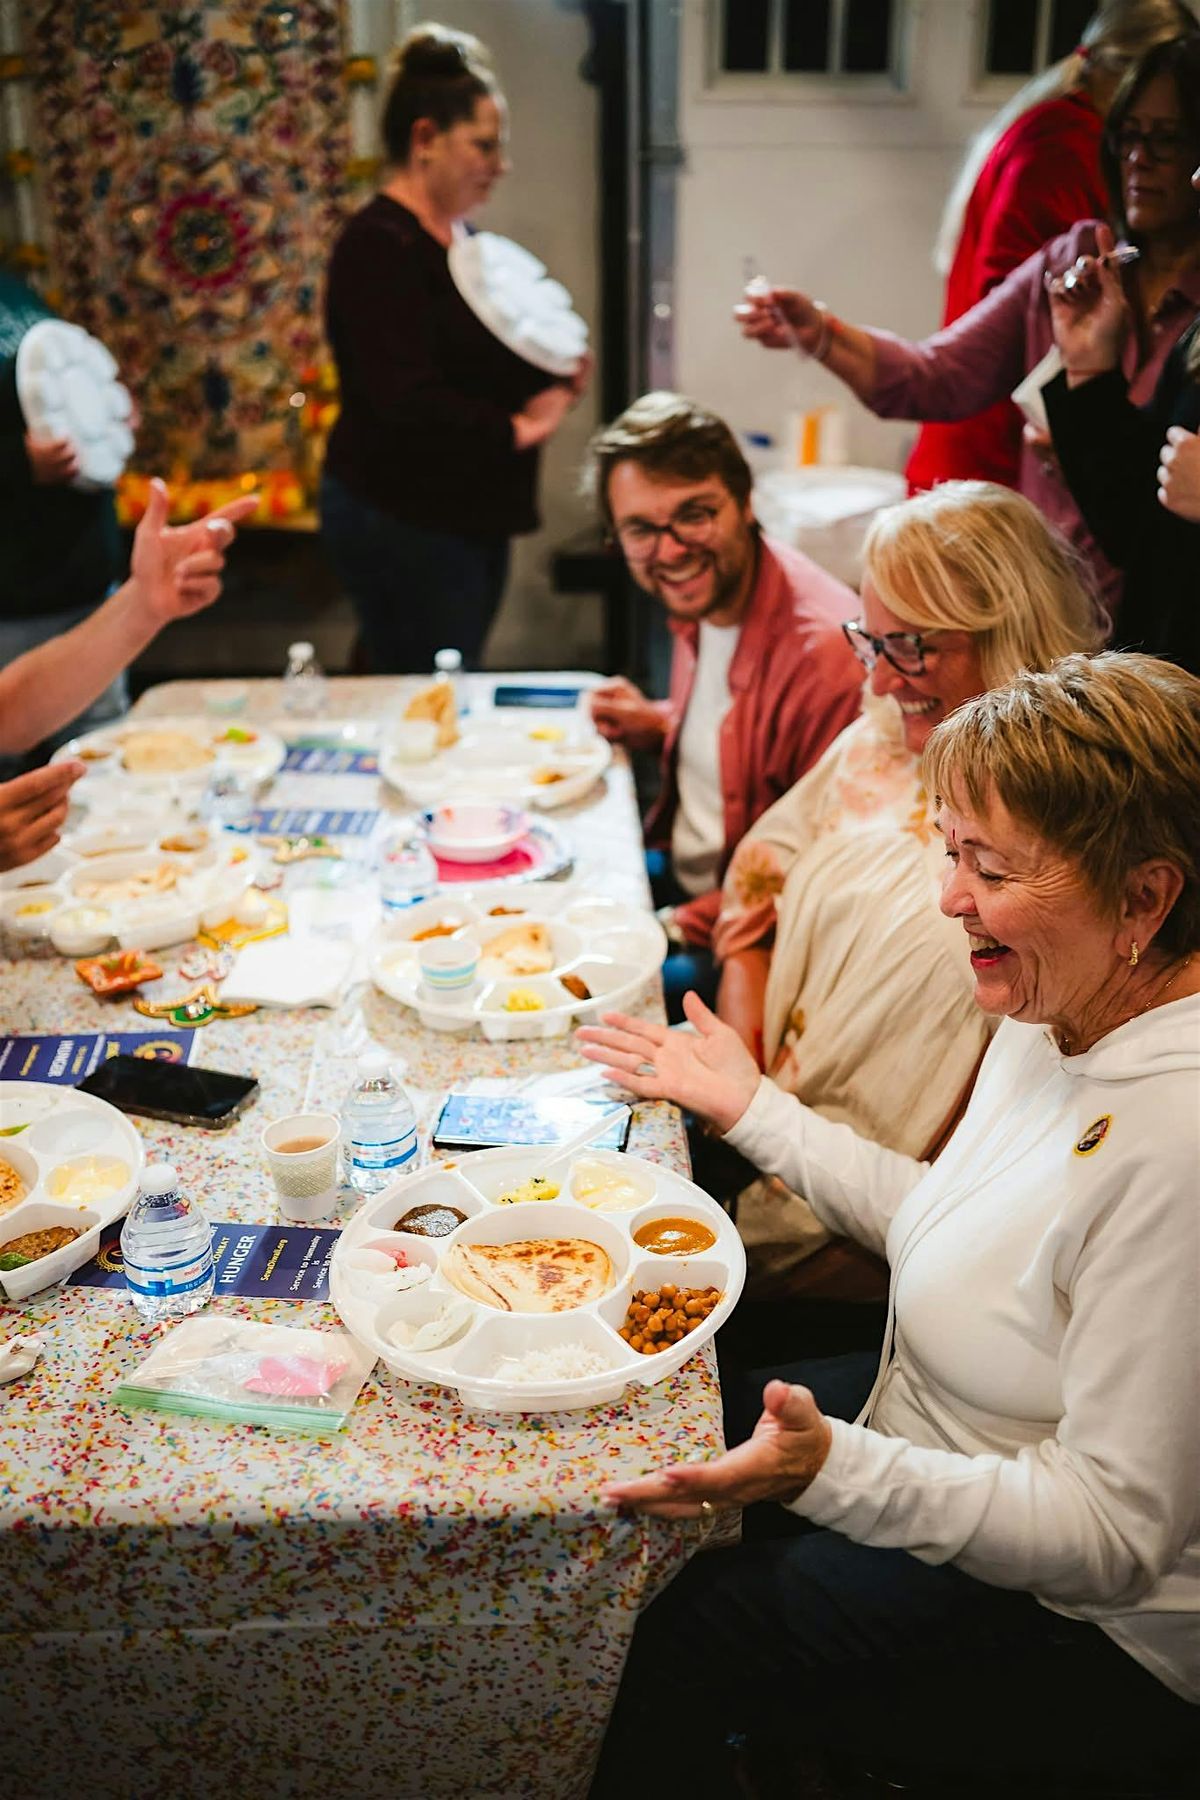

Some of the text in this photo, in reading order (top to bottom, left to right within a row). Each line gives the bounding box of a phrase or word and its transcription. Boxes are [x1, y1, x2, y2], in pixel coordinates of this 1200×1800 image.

[219, 1235, 257, 1283] HUNGER
[261, 1238, 288, 1281] SewaDiwali.org
[289, 1269, 306, 1291] Service
[302, 1234, 322, 1261] Humanity
[312, 1267, 328, 1289] Service
